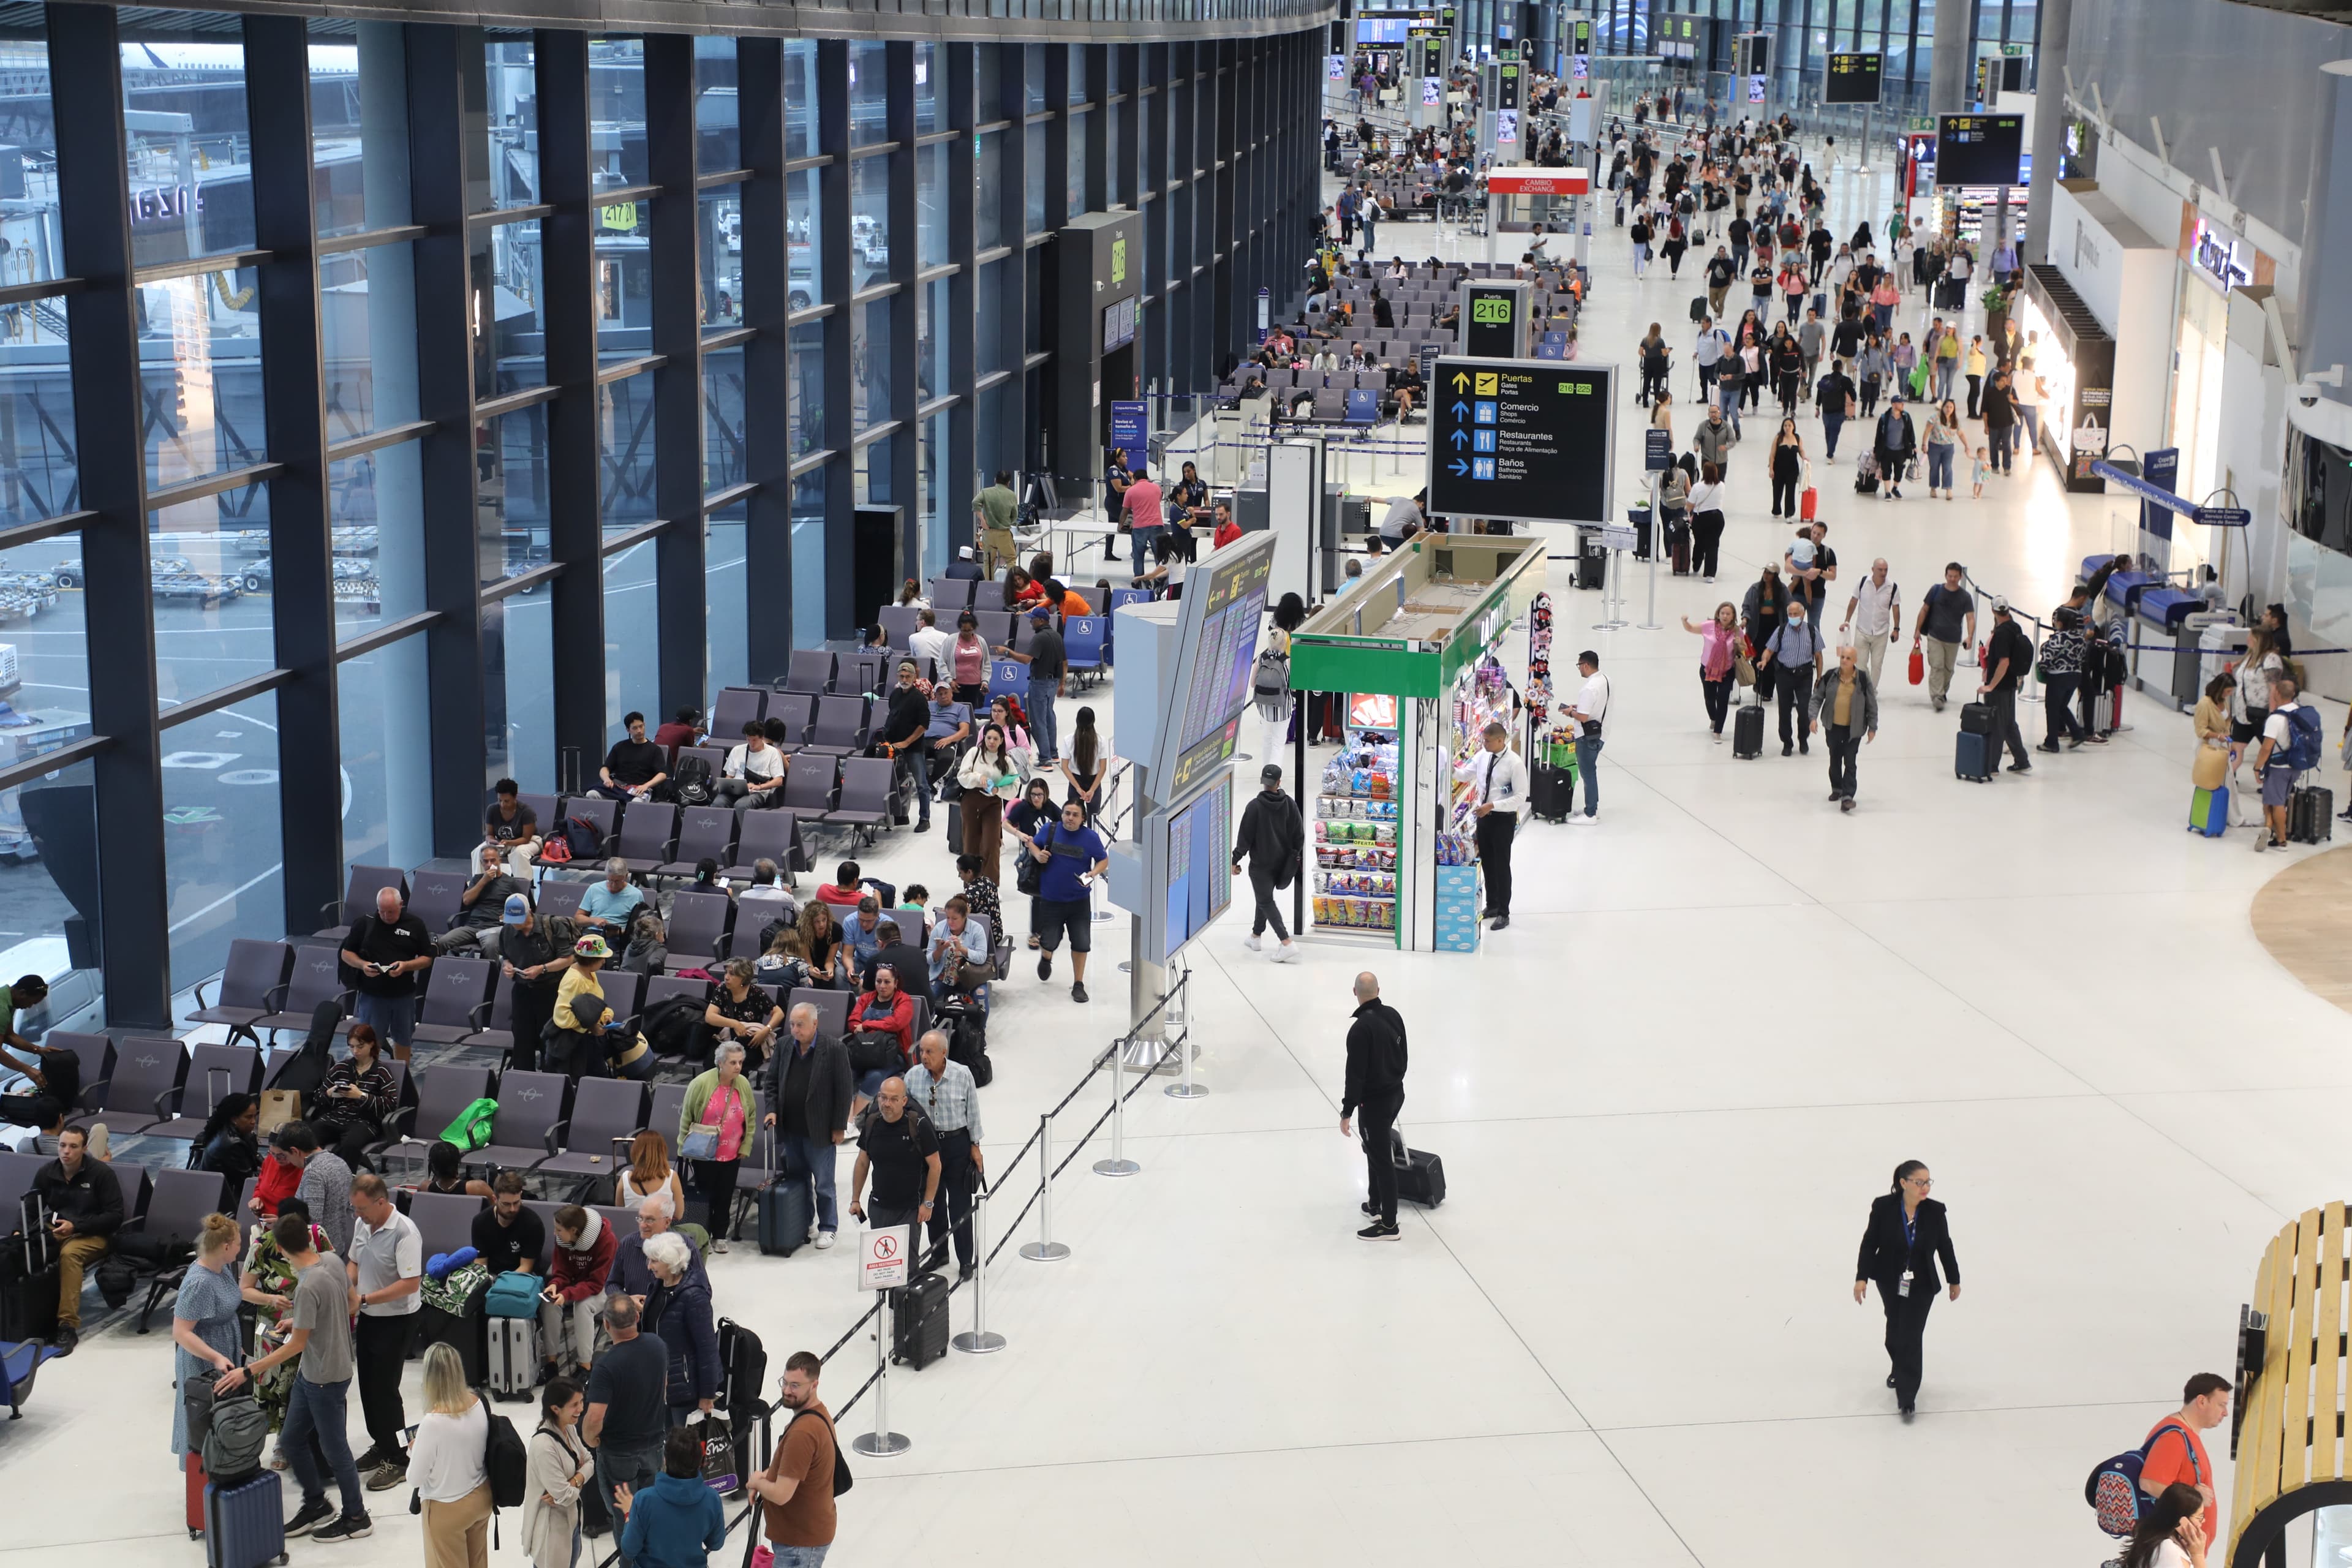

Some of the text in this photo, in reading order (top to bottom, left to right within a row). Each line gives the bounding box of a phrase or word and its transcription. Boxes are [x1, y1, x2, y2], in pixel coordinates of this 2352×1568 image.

[1503, 67, 1517, 75] 217
[1113, 247, 1125, 275] 216
[1476, 303, 1507, 318] 216
[1501, 374, 1532, 383] Puertas
[1559, 384, 1573, 393] 216
[1501, 402, 1539, 412] Comercio
[1499, 431, 1553, 440] Restaurantes
[1499, 459, 1525, 467] Baños
